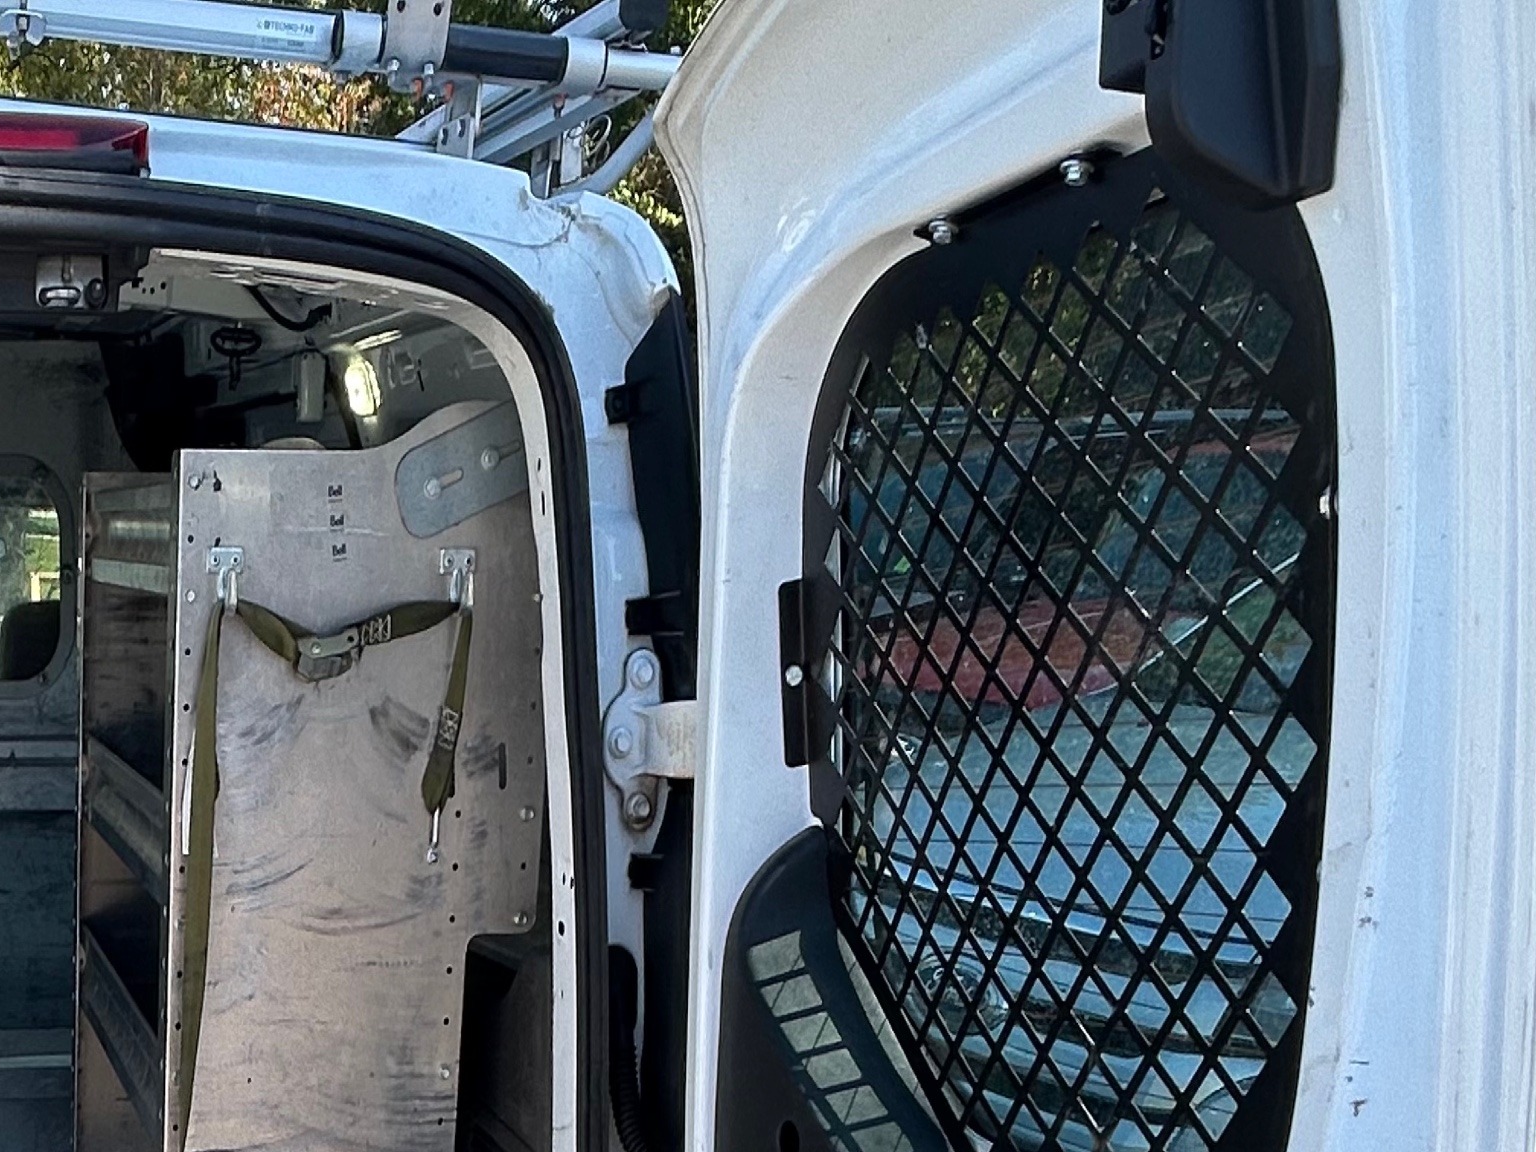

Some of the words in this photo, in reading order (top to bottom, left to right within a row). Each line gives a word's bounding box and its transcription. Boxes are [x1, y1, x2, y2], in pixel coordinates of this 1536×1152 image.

[328, 485, 343, 497] Bell
[330, 514, 345, 527] Bell
[332, 543, 346, 557] Bell
